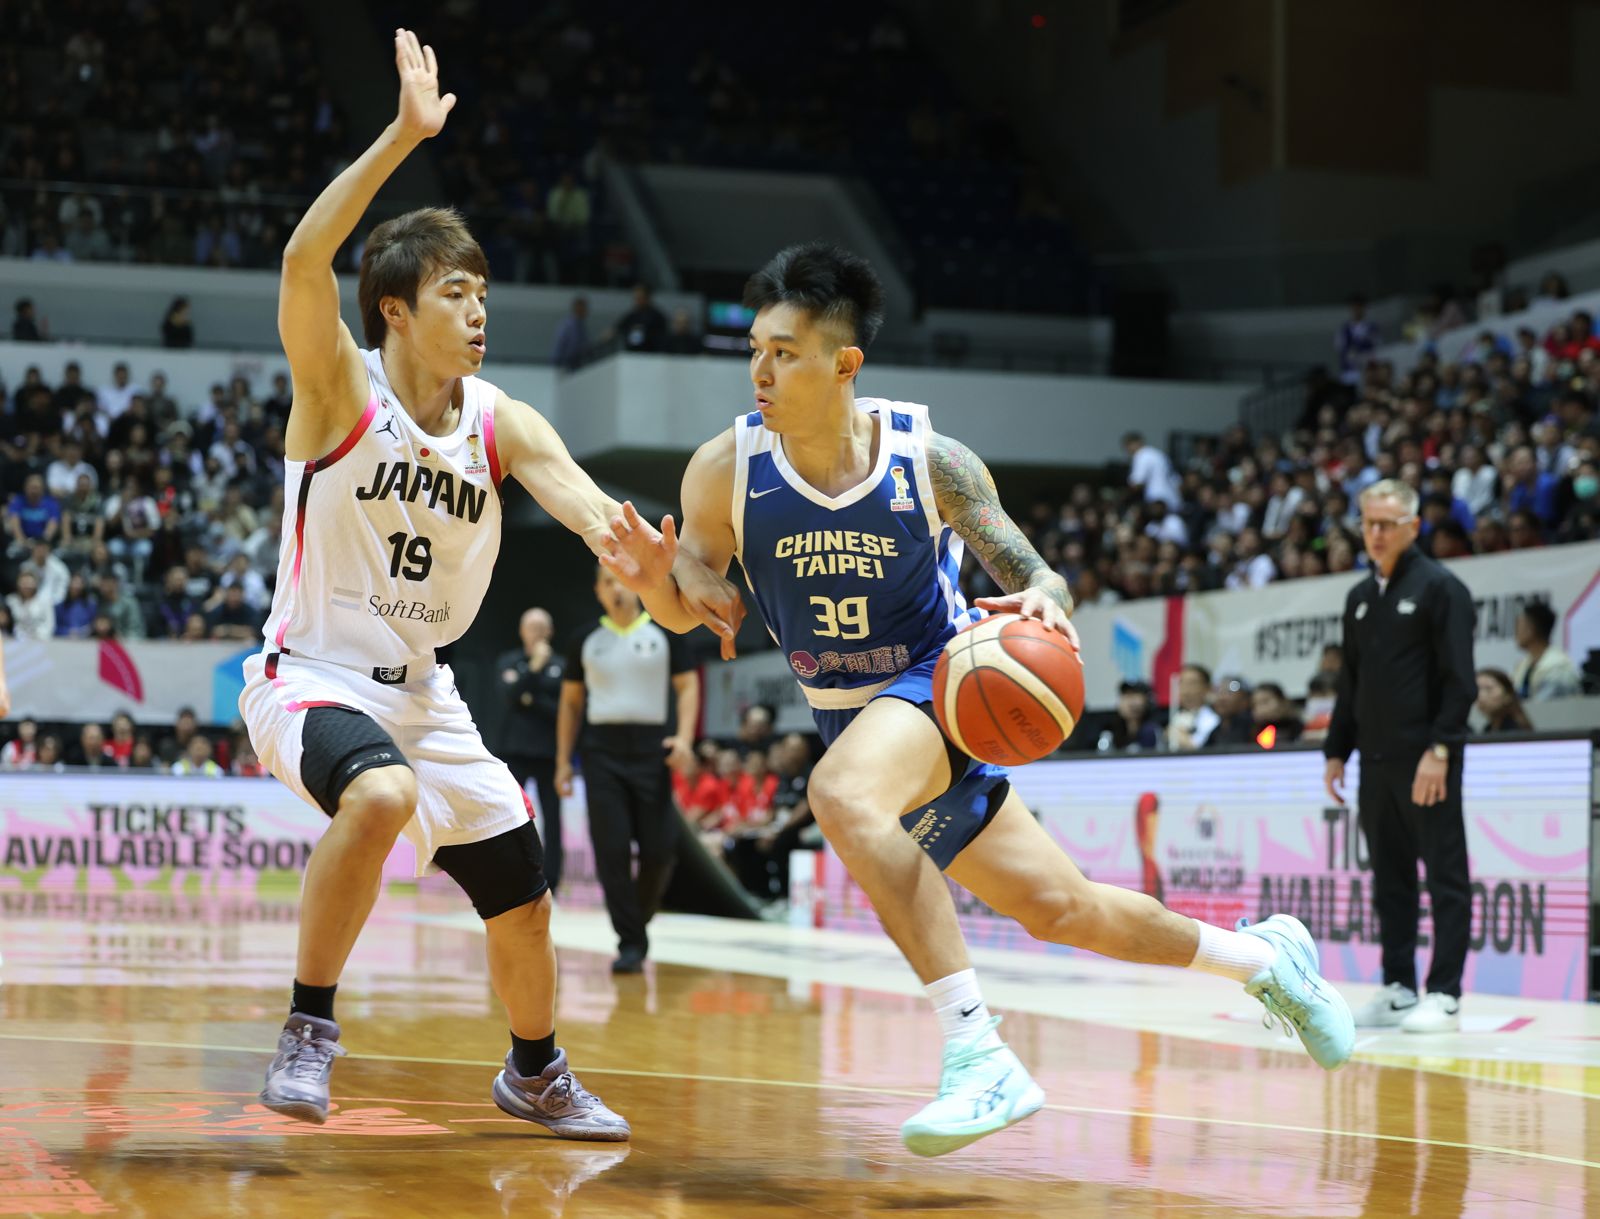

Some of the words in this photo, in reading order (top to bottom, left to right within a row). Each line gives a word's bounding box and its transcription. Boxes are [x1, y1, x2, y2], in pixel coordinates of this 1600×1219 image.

[356, 462, 488, 525] JAPAN
[387, 532, 433, 582] 19
[775, 531, 899, 558] CHINESE
[793, 555, 884, 579] TAIPEI
[368, 595, 452, 624] SoftBank
[809, 596, 870, 640] 39
[89, 804, 245, 835] TICKETS
[4, 836, 211, 870] AVAILABLE
